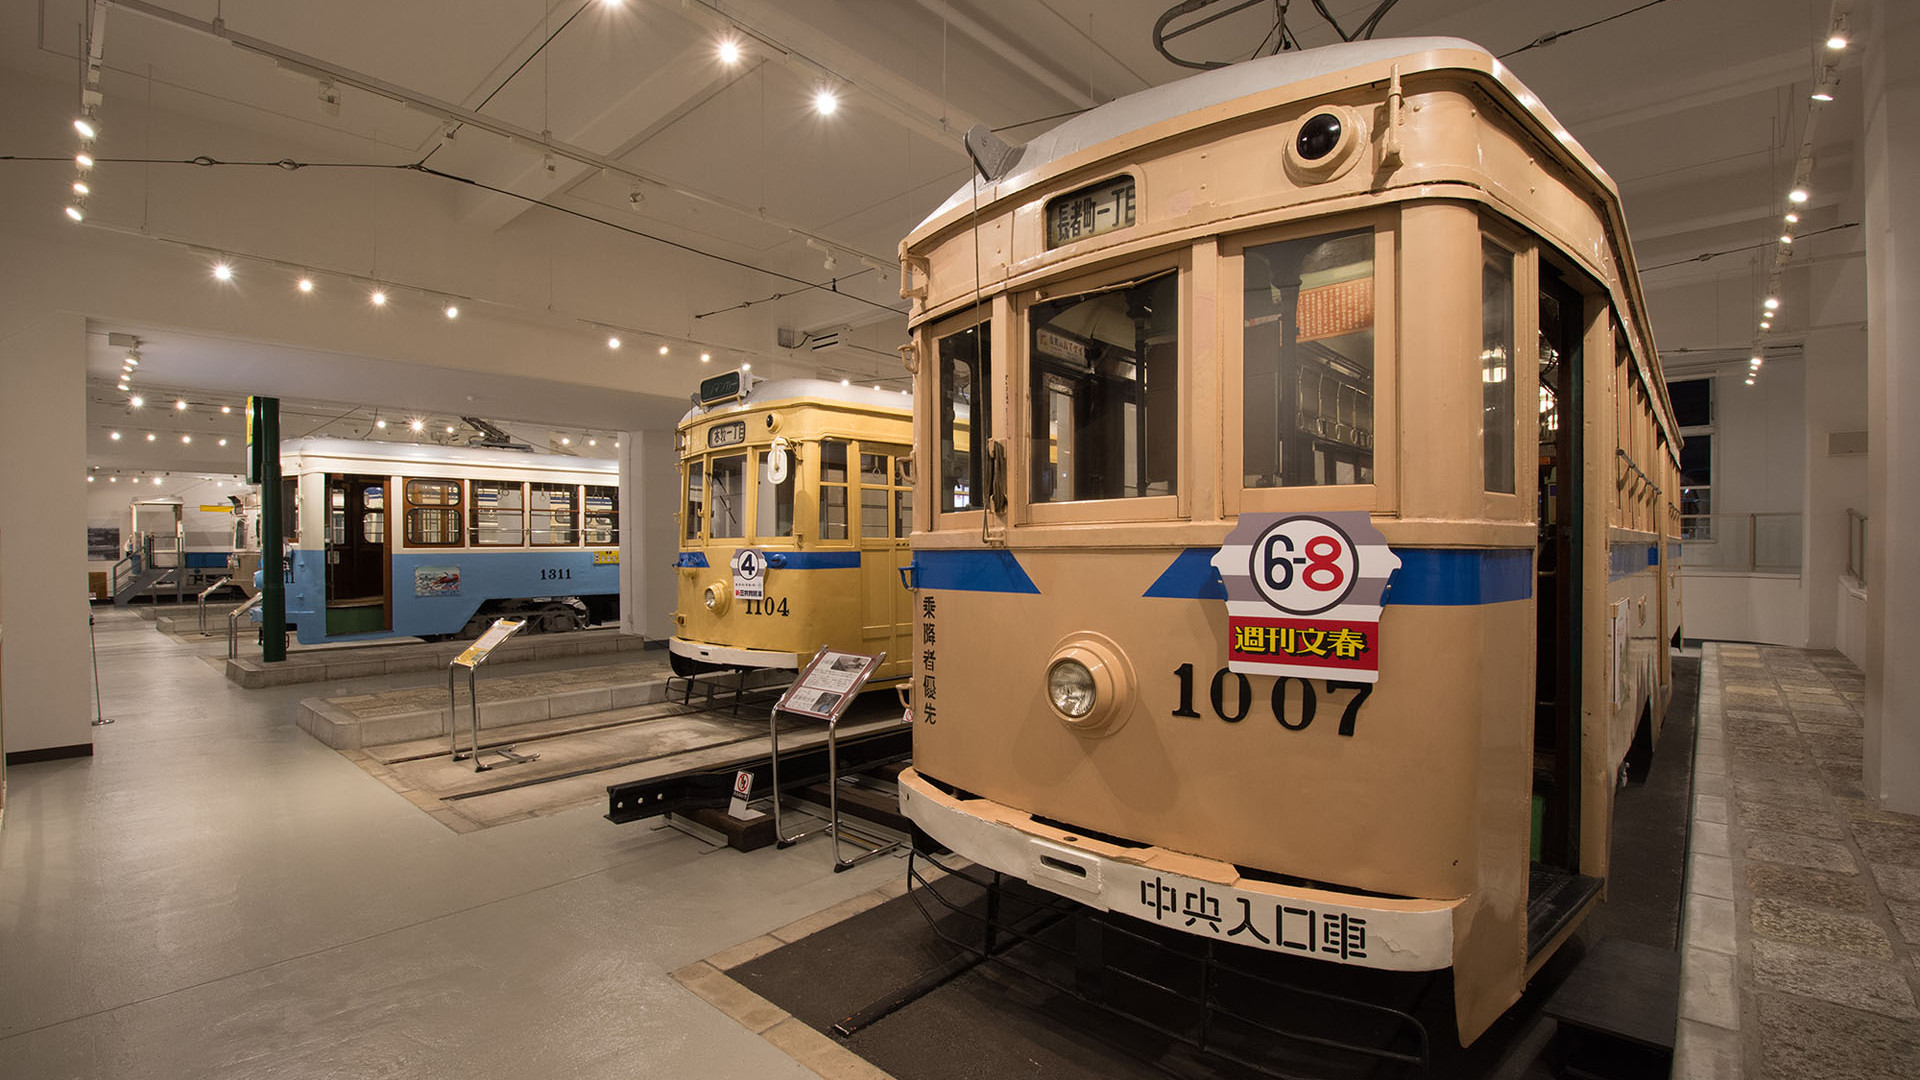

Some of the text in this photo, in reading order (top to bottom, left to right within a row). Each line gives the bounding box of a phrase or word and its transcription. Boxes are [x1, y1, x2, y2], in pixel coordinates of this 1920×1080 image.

[1057, 184, 1135, 241] 長者町一丁目
[540, 568, 572, 580] 1311
[741, 554, 755, 575] 4
[1264, 534, 1344, 591] 6-8
[745, 597, 790, 617] 1104
[923, 596, 937, 725] 乗降者優先
[1235, 626, 1367, 660] 週刊文春
[1172, 662, 1373, 737] 1007
[1140, 877, 1367, 960] 中央入口車
